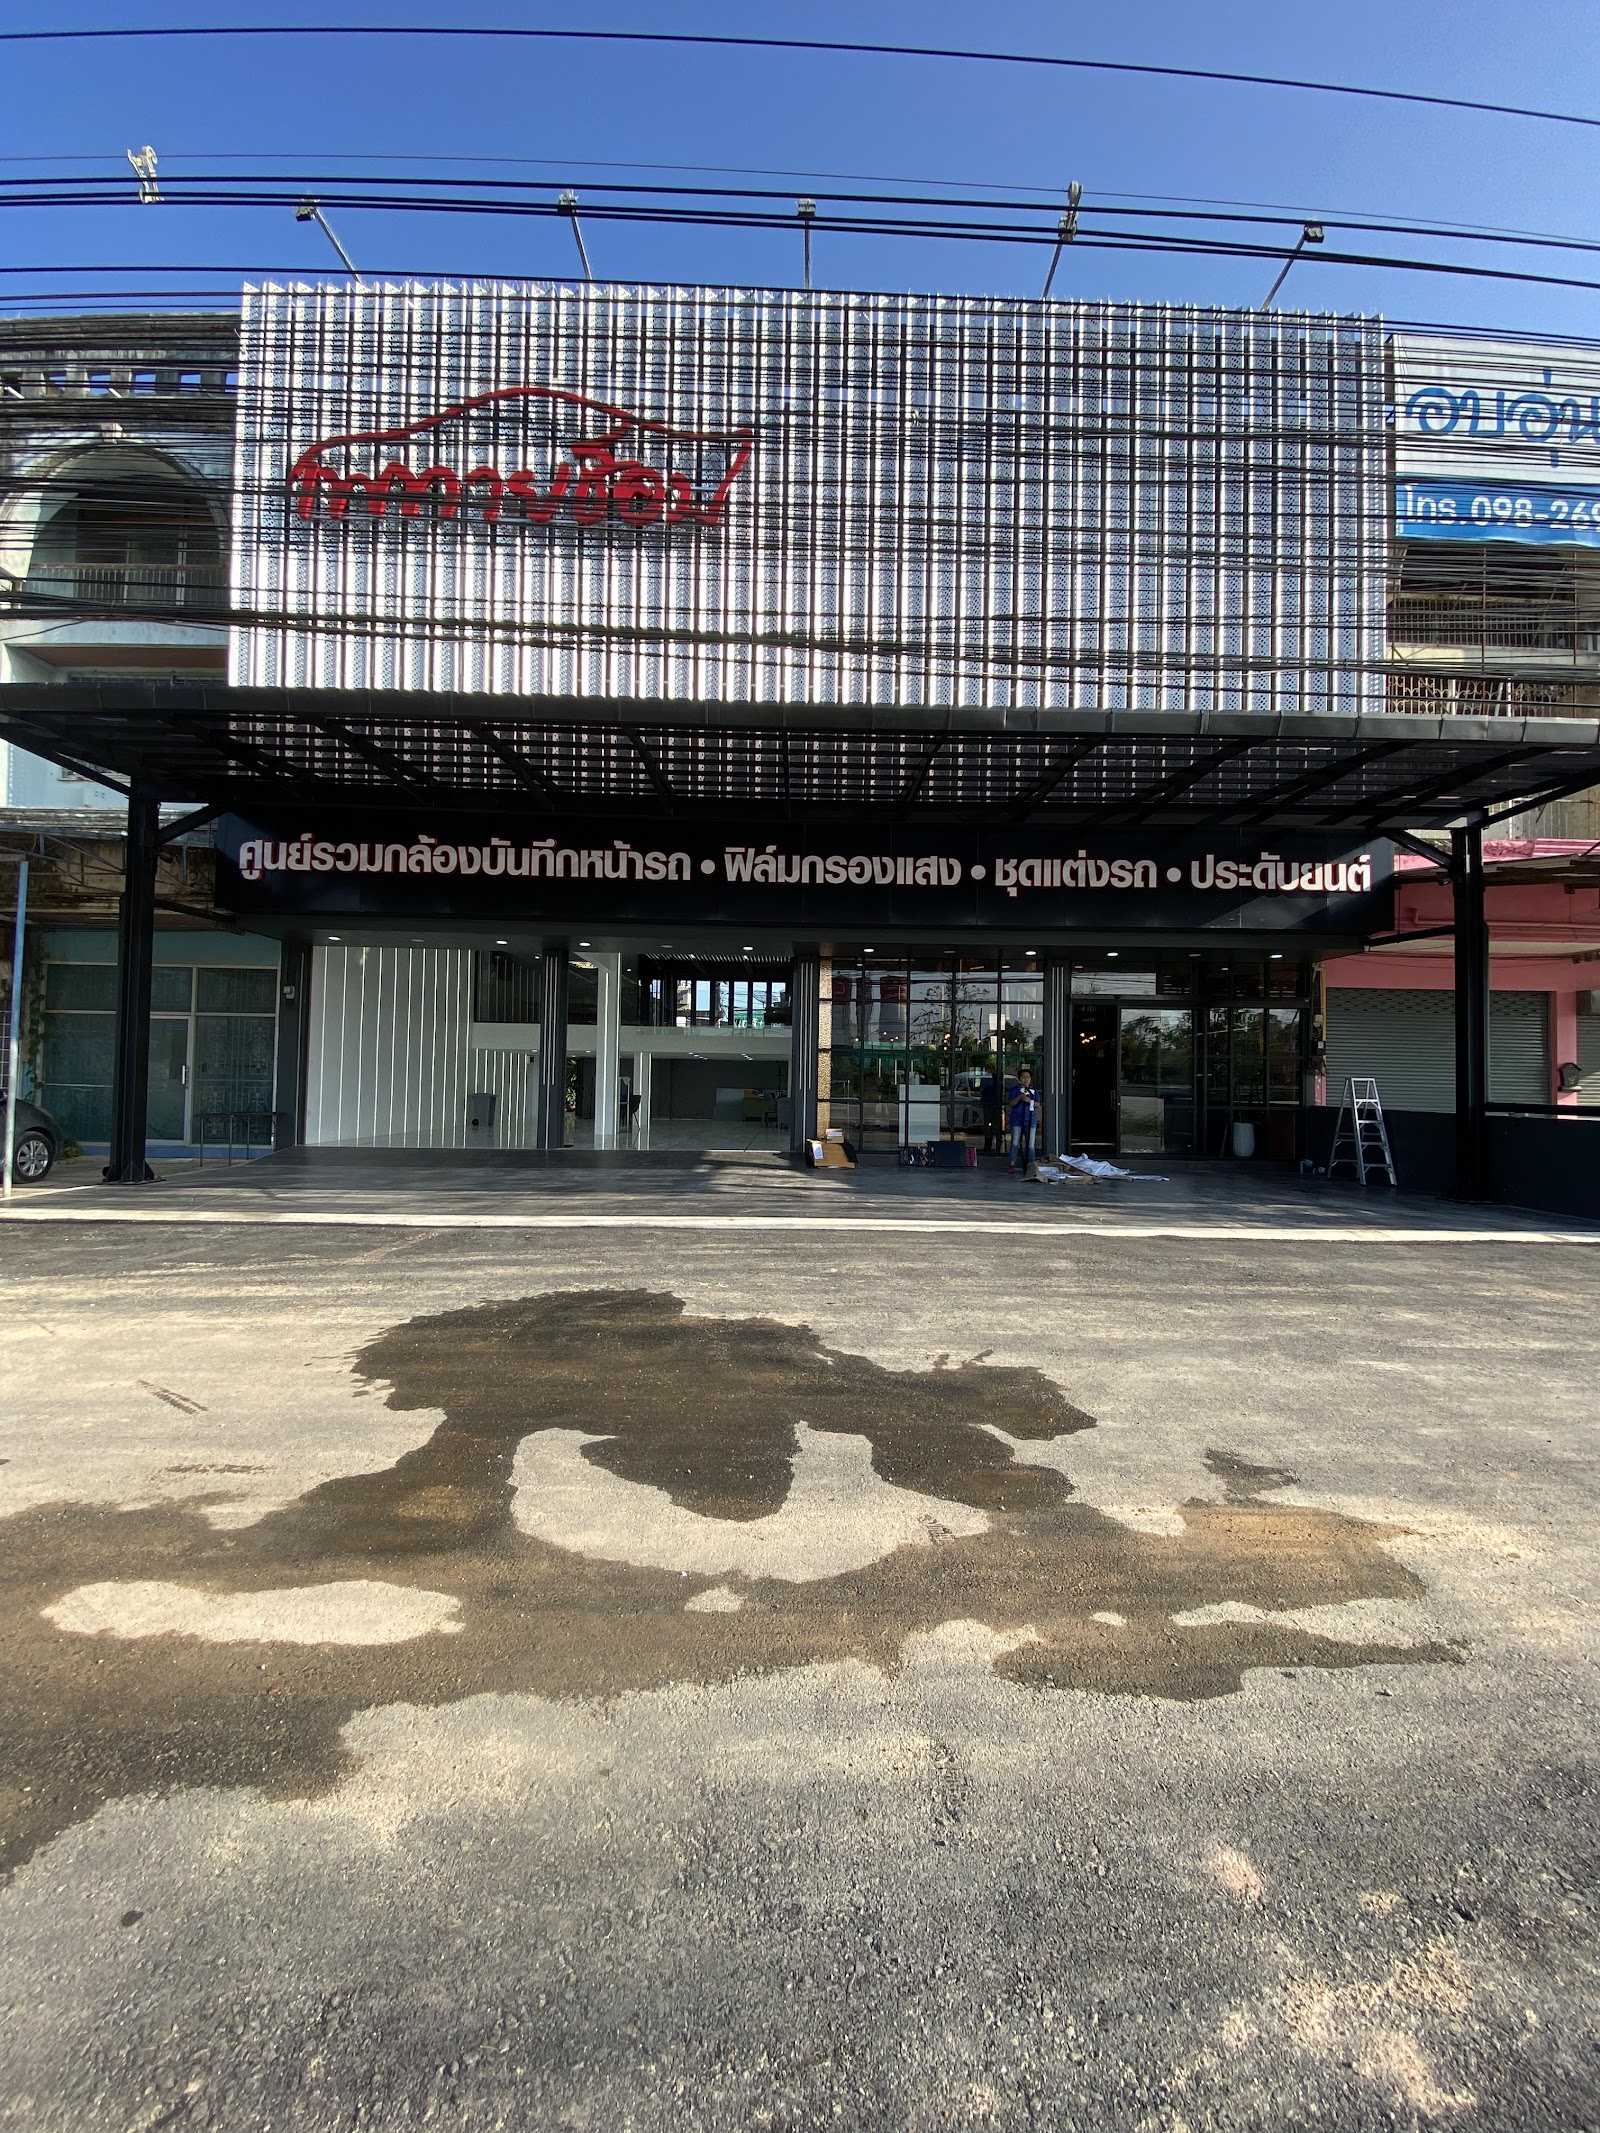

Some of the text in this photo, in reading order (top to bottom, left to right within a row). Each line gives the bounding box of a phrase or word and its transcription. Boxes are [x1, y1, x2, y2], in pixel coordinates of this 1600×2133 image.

[239, 834, 1372, 896] ศูนย์รวมกล้องบันทึกหน้ารถ ฟิล์มกรองแสง ชุดแต่งรถ ประดับยนต์
